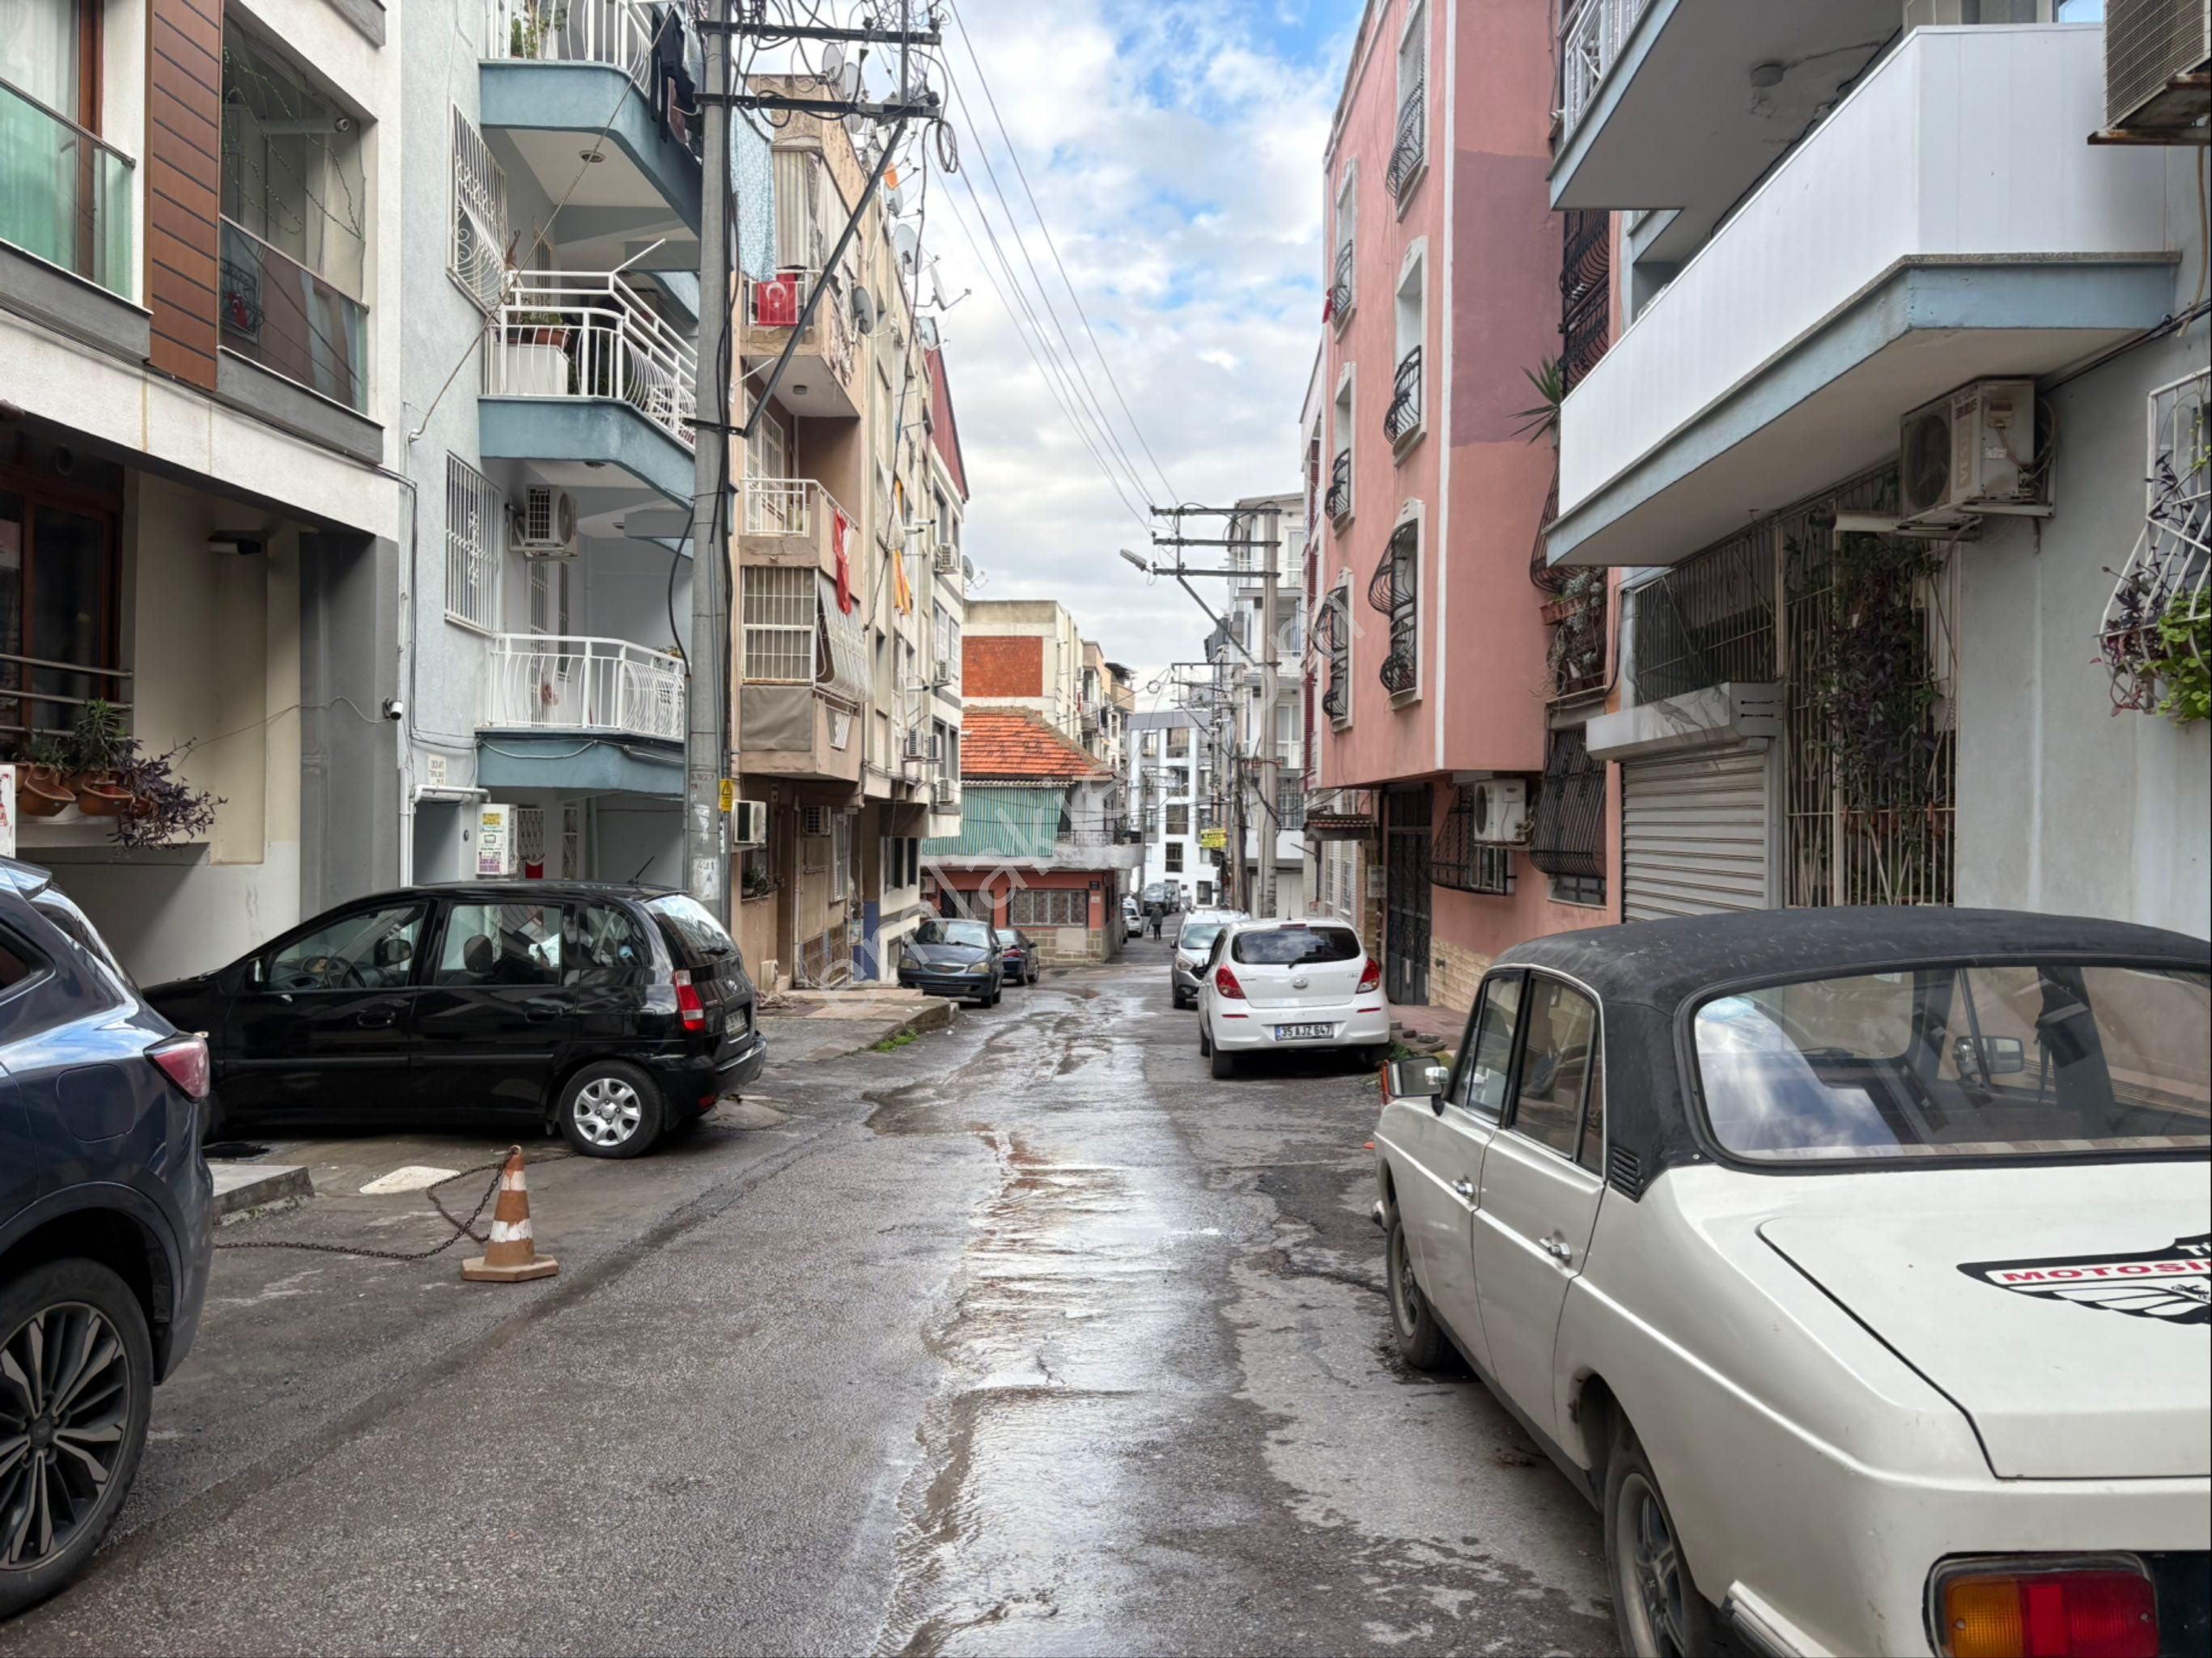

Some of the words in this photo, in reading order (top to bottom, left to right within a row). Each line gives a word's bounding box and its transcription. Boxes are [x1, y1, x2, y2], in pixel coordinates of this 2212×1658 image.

[1281, 1027, 1293, 1037] 35
[1295, 1026, 1313, 1036] AJZ
[2002, 1260, 2210, 1282] MOTOSİ
